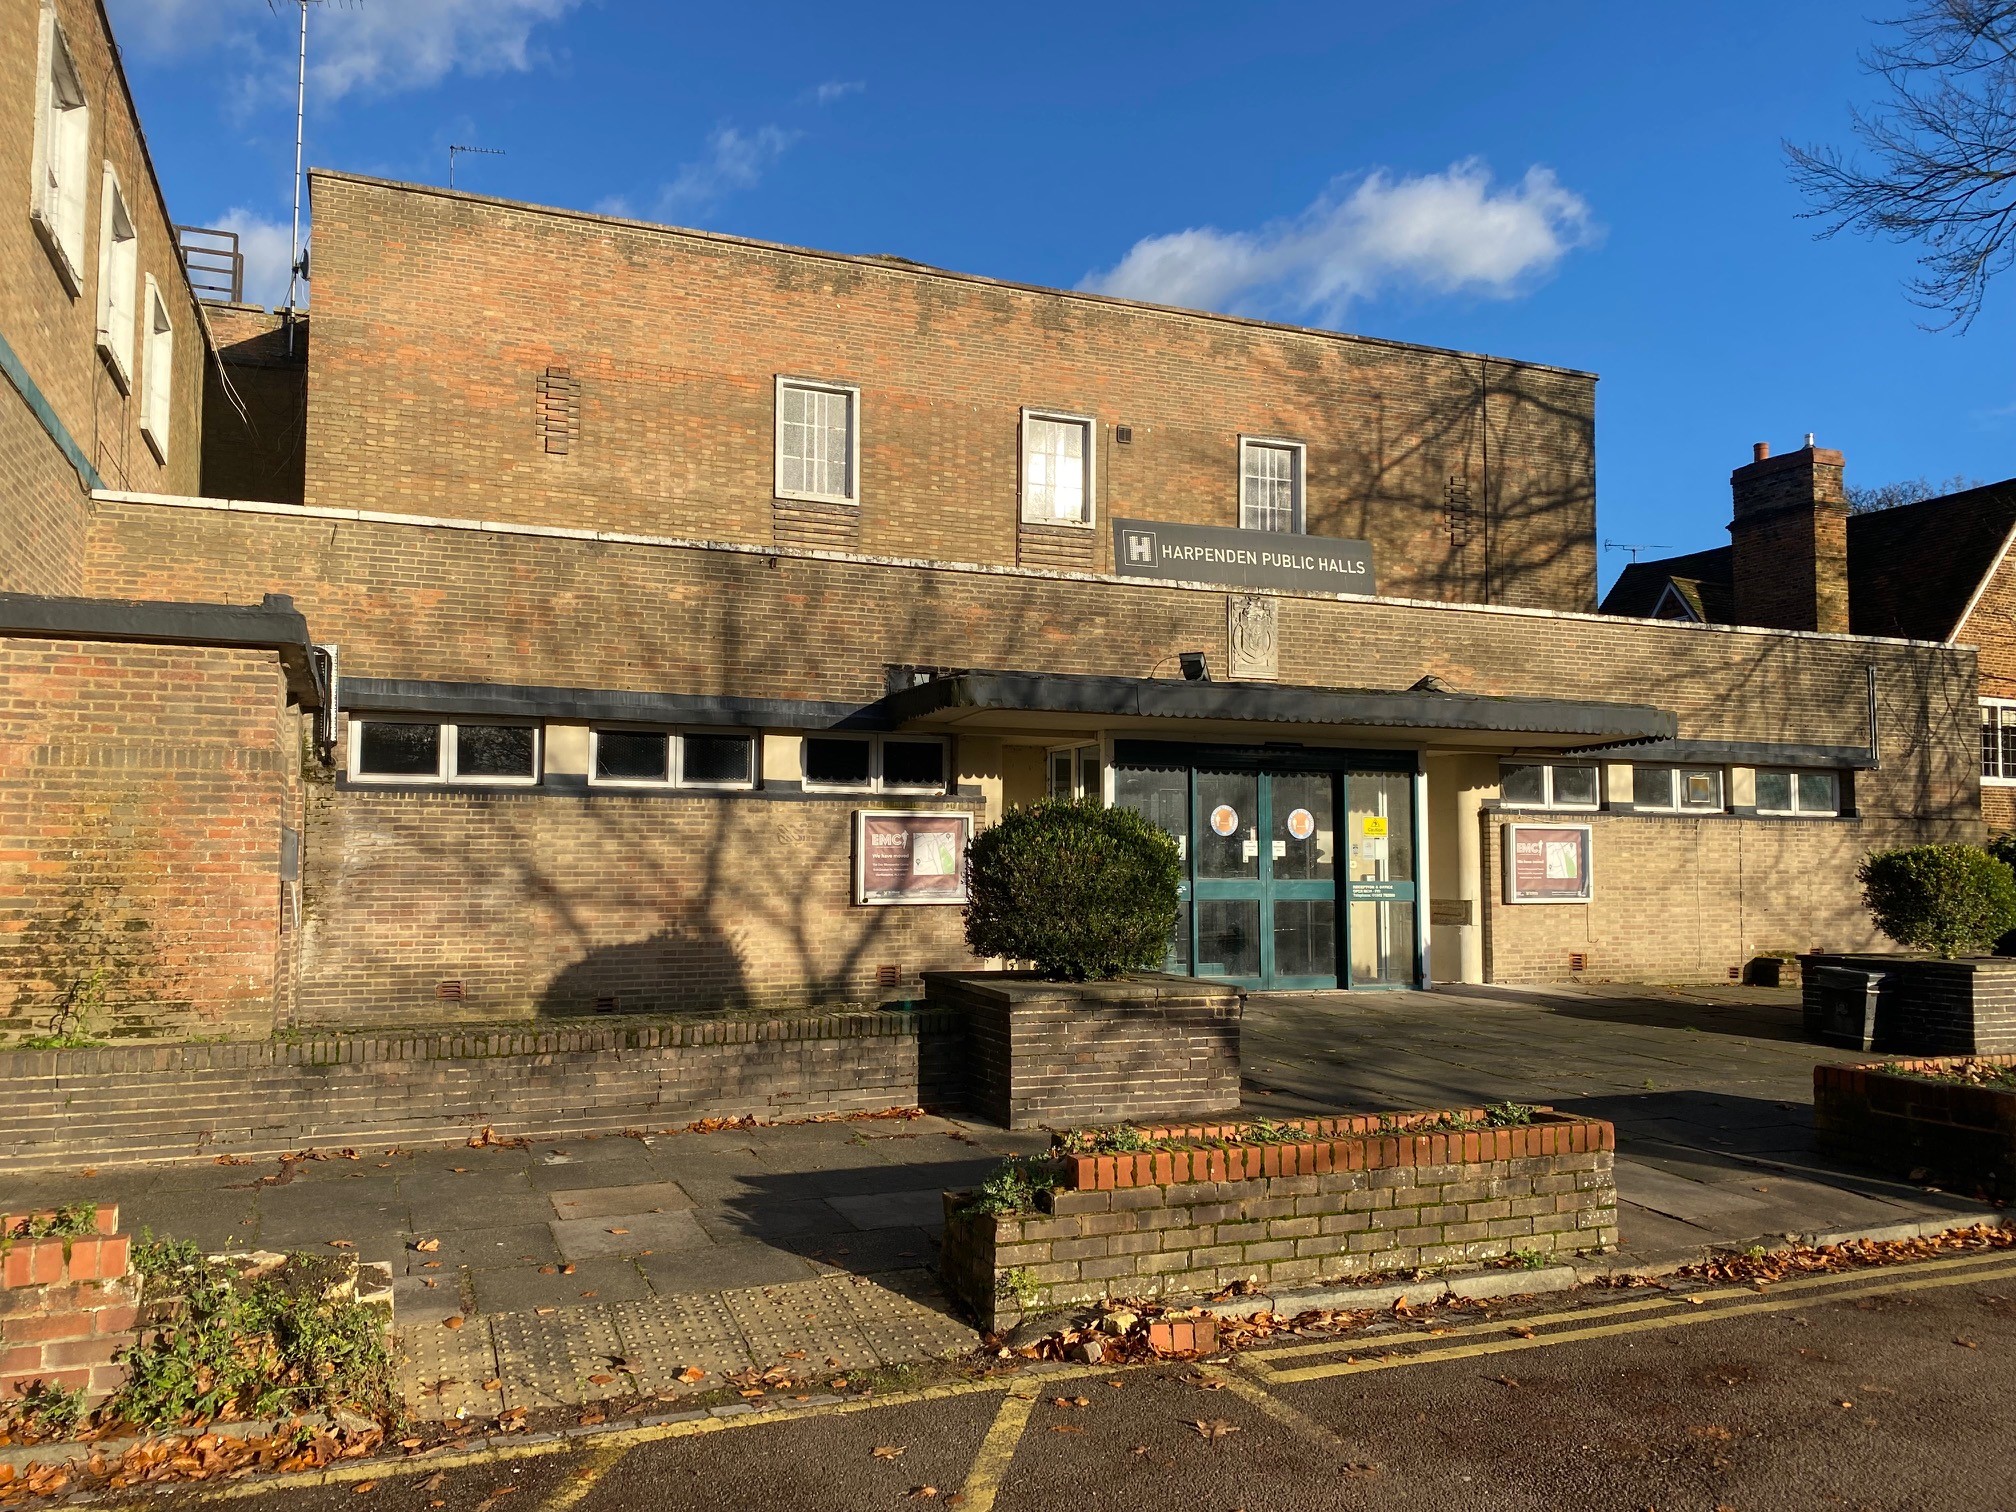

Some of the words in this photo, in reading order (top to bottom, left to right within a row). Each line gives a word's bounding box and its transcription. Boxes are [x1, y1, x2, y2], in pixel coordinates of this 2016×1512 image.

[1129, 535, 1152, 562] H
[1162, 544, 1257, 566] HARPENDEN
[1262, 553, 1315, 570] PUBLIC
[1319, 558, 1366, 575] HALLS
[872, 834, 902, 846] EMC
[1517, 842, 1538, 853] EMC
